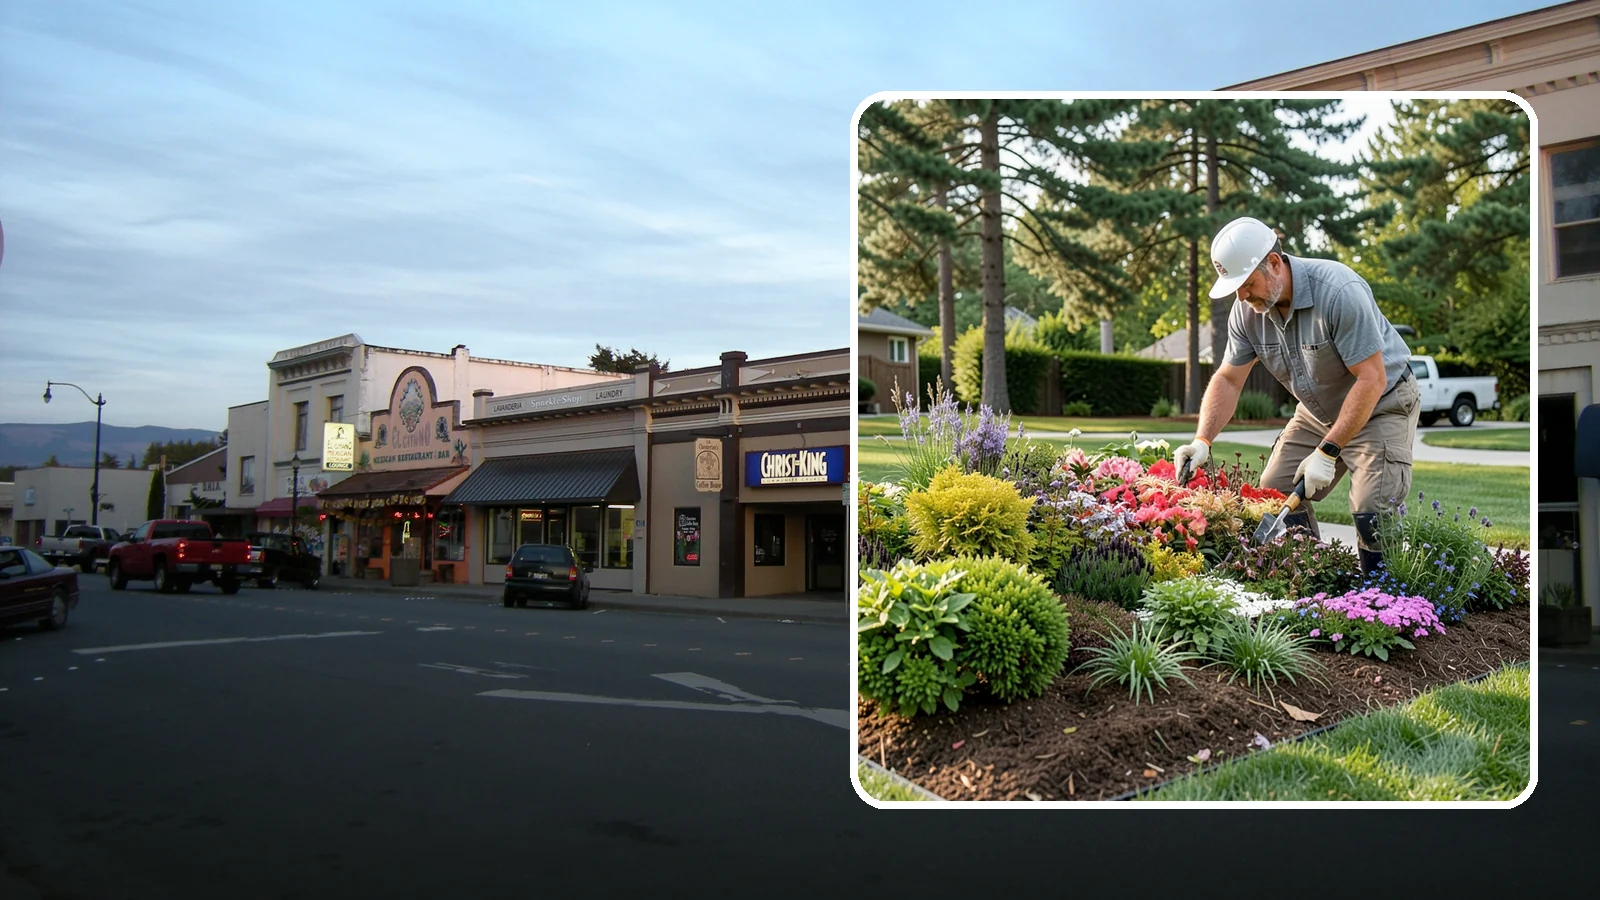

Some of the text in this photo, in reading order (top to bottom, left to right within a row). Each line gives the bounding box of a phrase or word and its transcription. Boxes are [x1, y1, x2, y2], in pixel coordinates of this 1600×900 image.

[494, 389, 624, 412] LAVANDERIA Sparkle Shop LAUNDRY
[373, 455, 396, 464] MEXICAN
[397, 451, 434, 462] RESTAURANT
[438, 450, 450, 459] BAR
